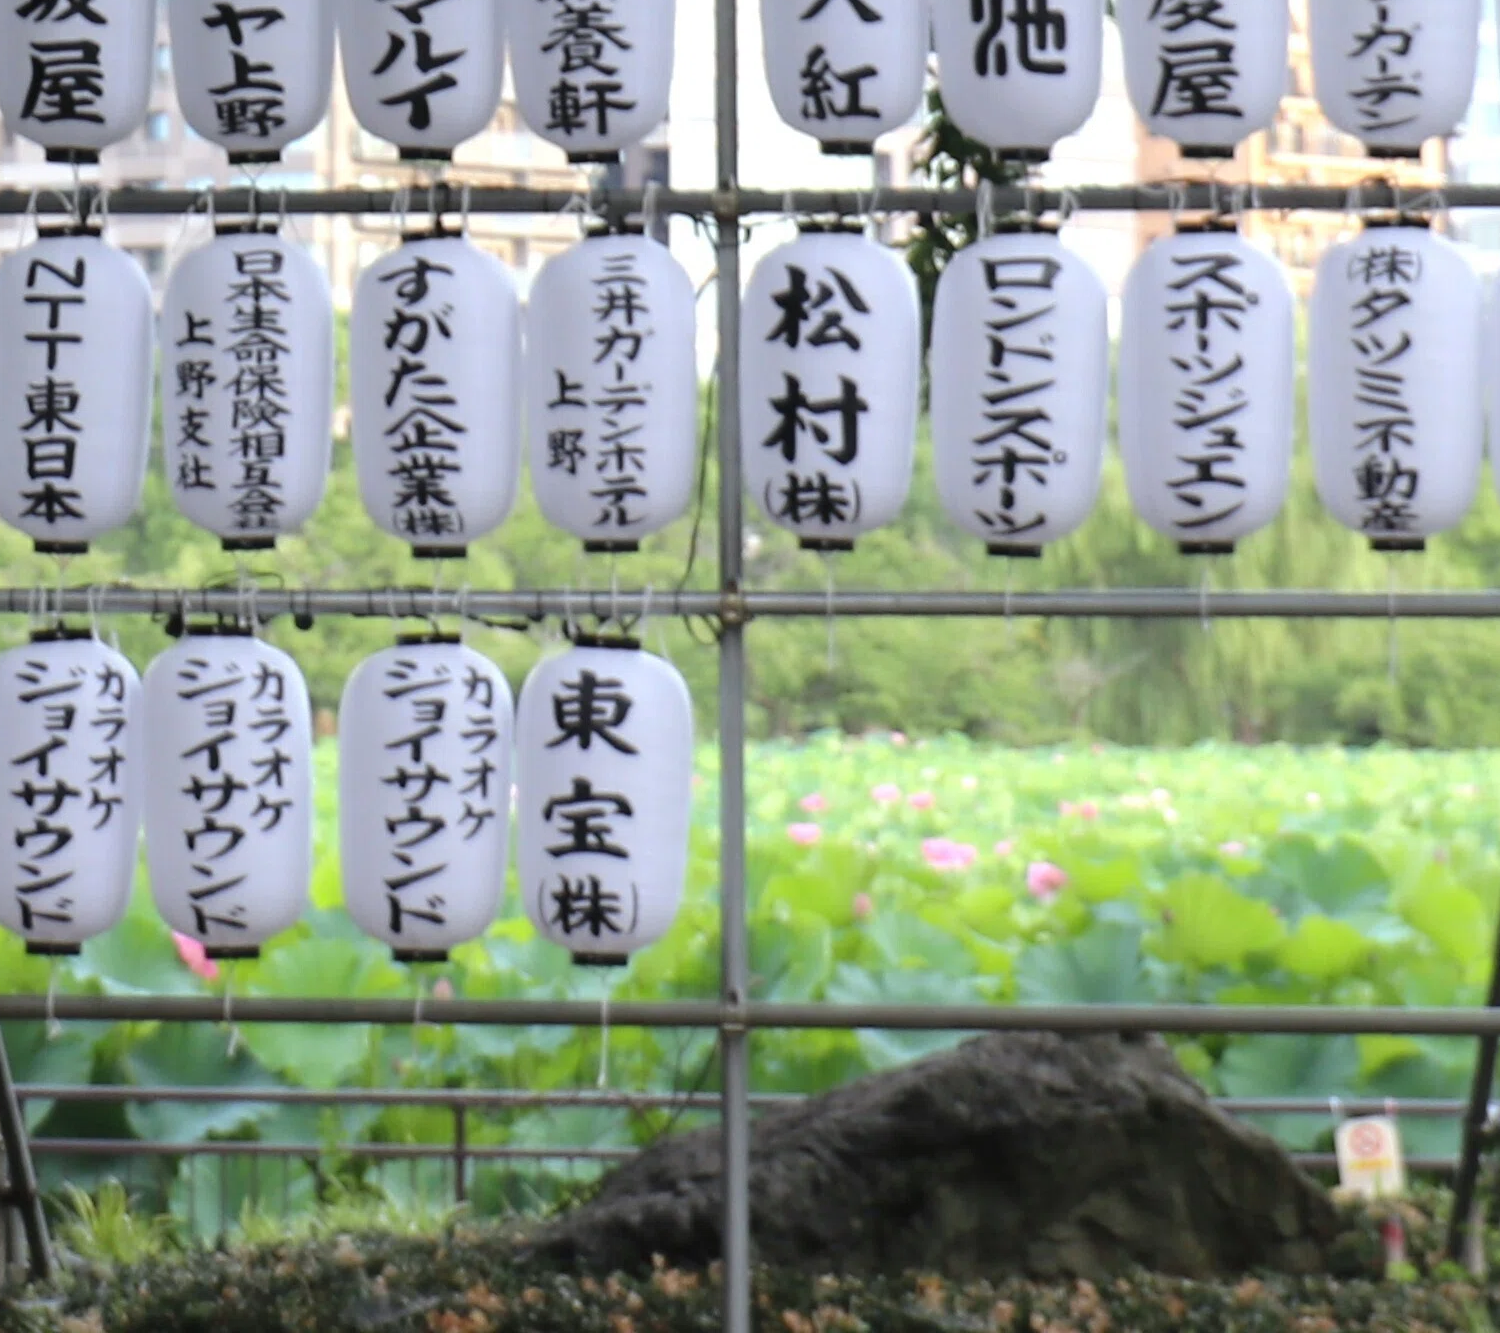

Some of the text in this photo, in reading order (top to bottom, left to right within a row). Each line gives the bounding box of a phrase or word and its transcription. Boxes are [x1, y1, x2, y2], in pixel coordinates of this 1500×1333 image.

[19, 258, 86, 525] NTT東日本
[175, 311, 217, 491] 上野支社
[225, 250, 291, 530] 日本生命保険相互会社
[378, 257, 467, 536] すがた企業(株)
[547, 370, 588, 476] 上野
[591, 255, 647, 528] 三井ガーデンホテル
[762, 264, 871, 527] 松村(株)
[973, 258, 1066, 536] ロンドンスポーツ
[1166, 255, 1259, 530] スポーツジュエン
[1345, 248, 1423, 532] (株)タツミ不動産
[11, 661, 87, 932] ジョイサウンド
[89, 665, 127, 830] カラオケ
[177, 659, 252, 936] ジョイサウンド
[250, 663, 293, 832] カラオケ
[381, 660, 451, 936] ジョイサウンド
[457, 668, 498, 838] カラオケ
[538, 670, 639, 939] 東宝(株)
